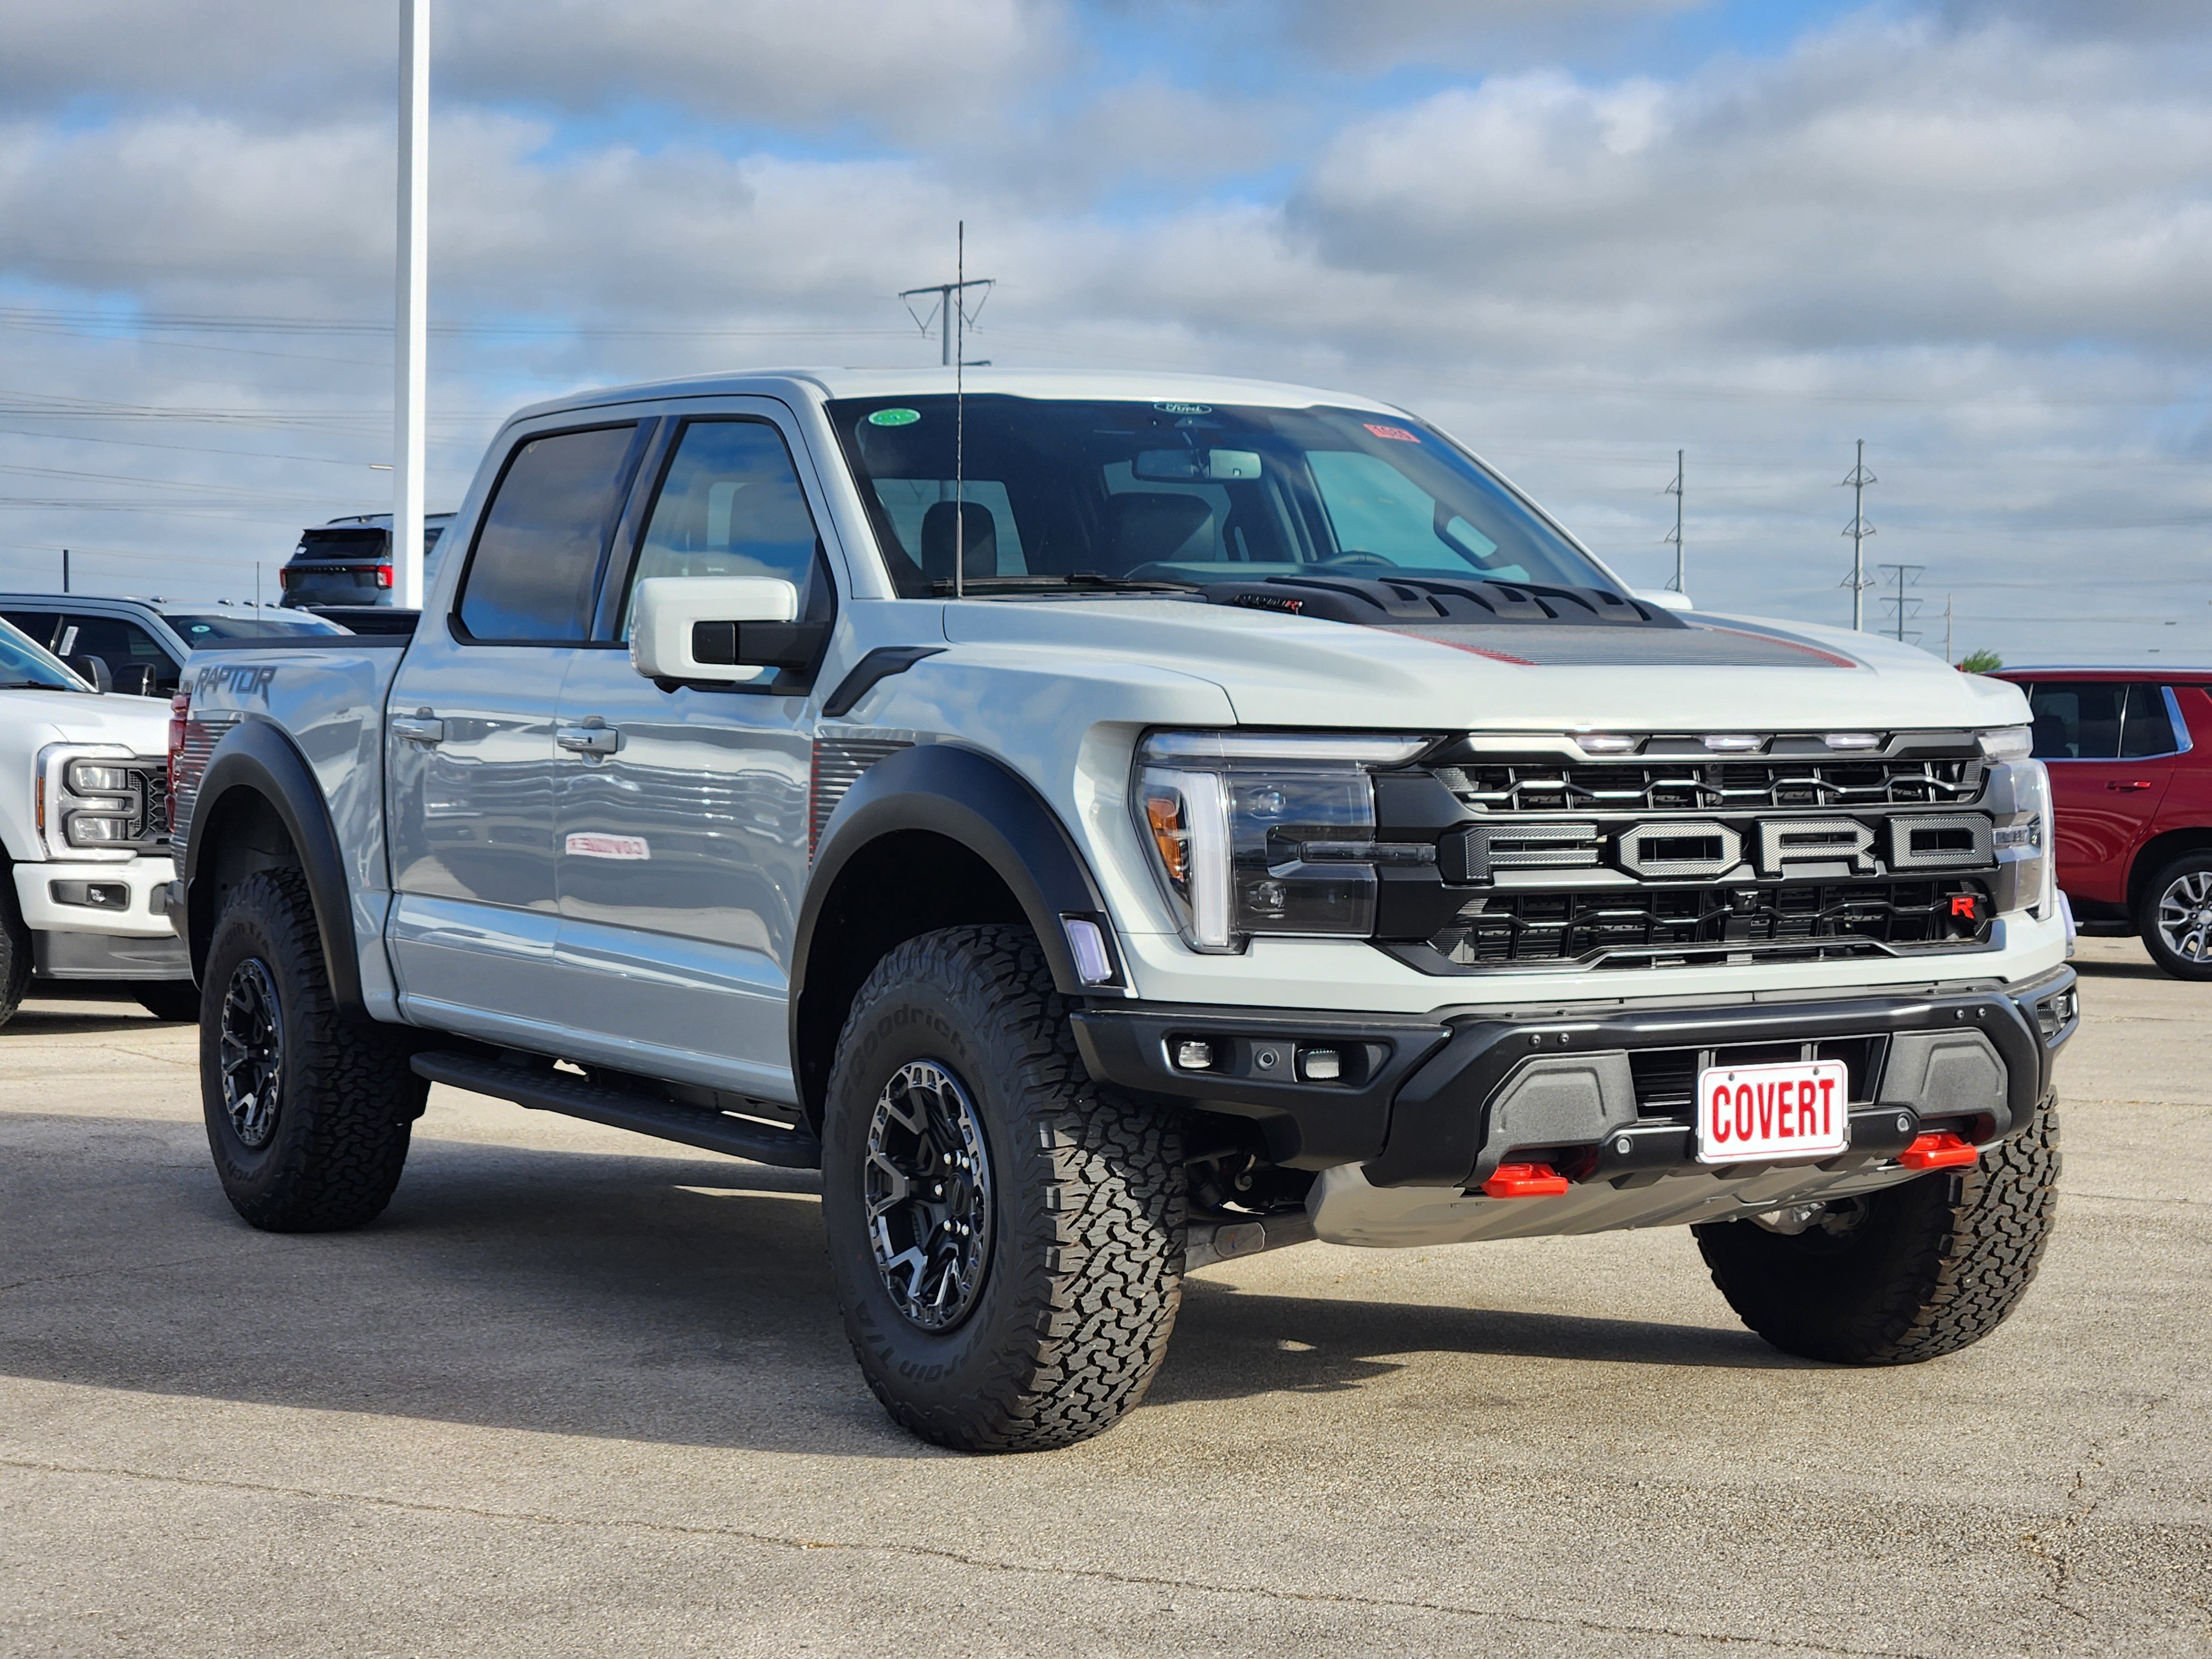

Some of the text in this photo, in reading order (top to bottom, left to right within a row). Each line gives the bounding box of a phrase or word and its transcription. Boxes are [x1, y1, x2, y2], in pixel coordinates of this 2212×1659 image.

[194, 665, 278, 709] RAPTOR
[1464, 815, 1992, 880] FORD
[1951, 897, 1975, 919] R
[1712, 1078, 1835, 1144] COVERT
